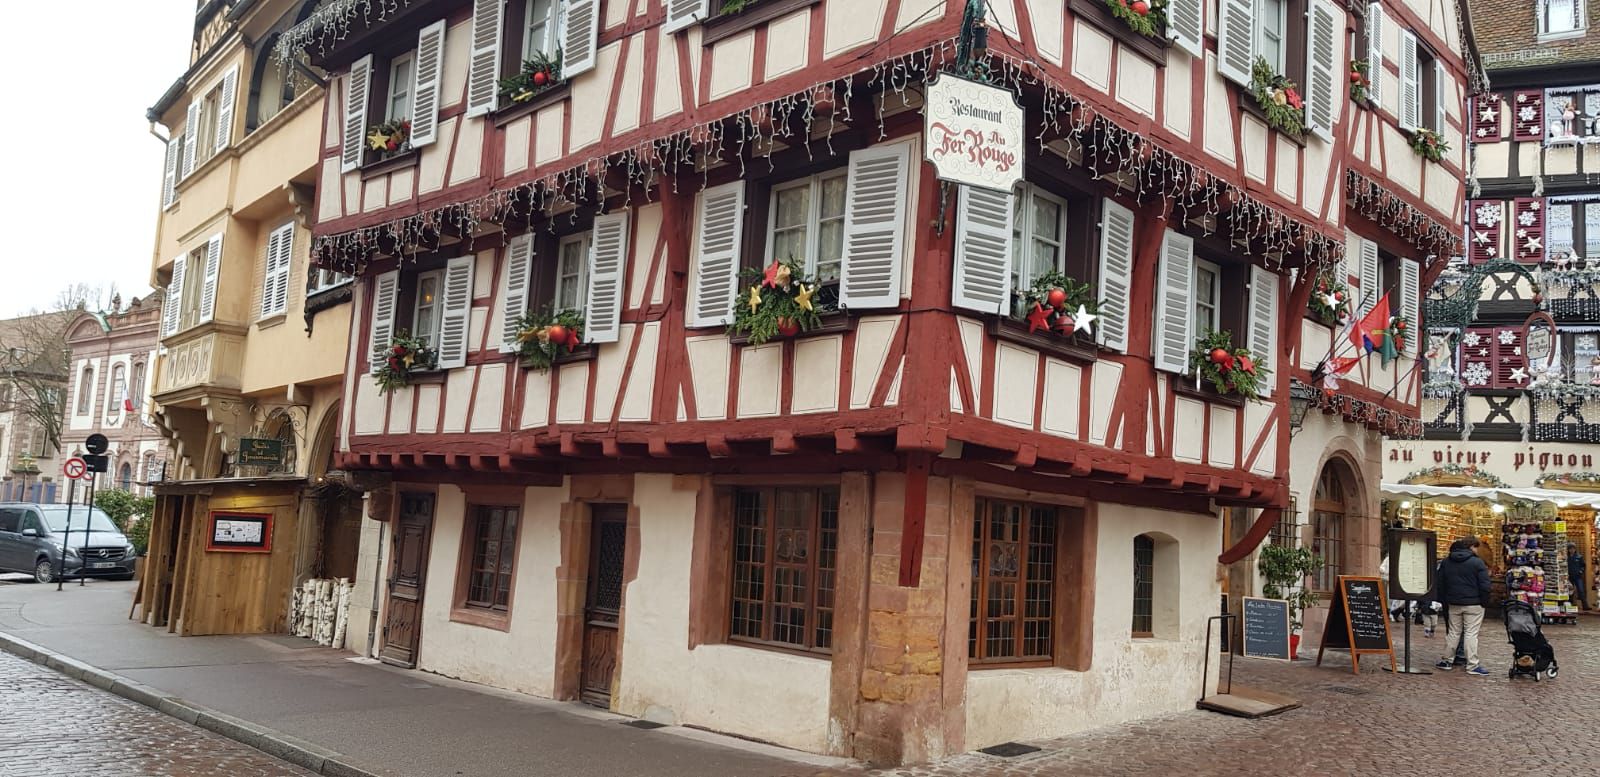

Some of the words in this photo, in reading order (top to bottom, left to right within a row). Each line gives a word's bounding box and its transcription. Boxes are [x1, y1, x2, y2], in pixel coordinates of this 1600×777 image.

[949, 96, 1002, 124] Restaurant
[930, 122, 966, 156] Fer
[964, 129, 1017, 172] Rouge
[988, 131, 1006, 146] Au
[1389, 447, 1413, 462] au
[1433, 445, 1492, 464] vieux
[1513, 446, 1593, 472] pignon
